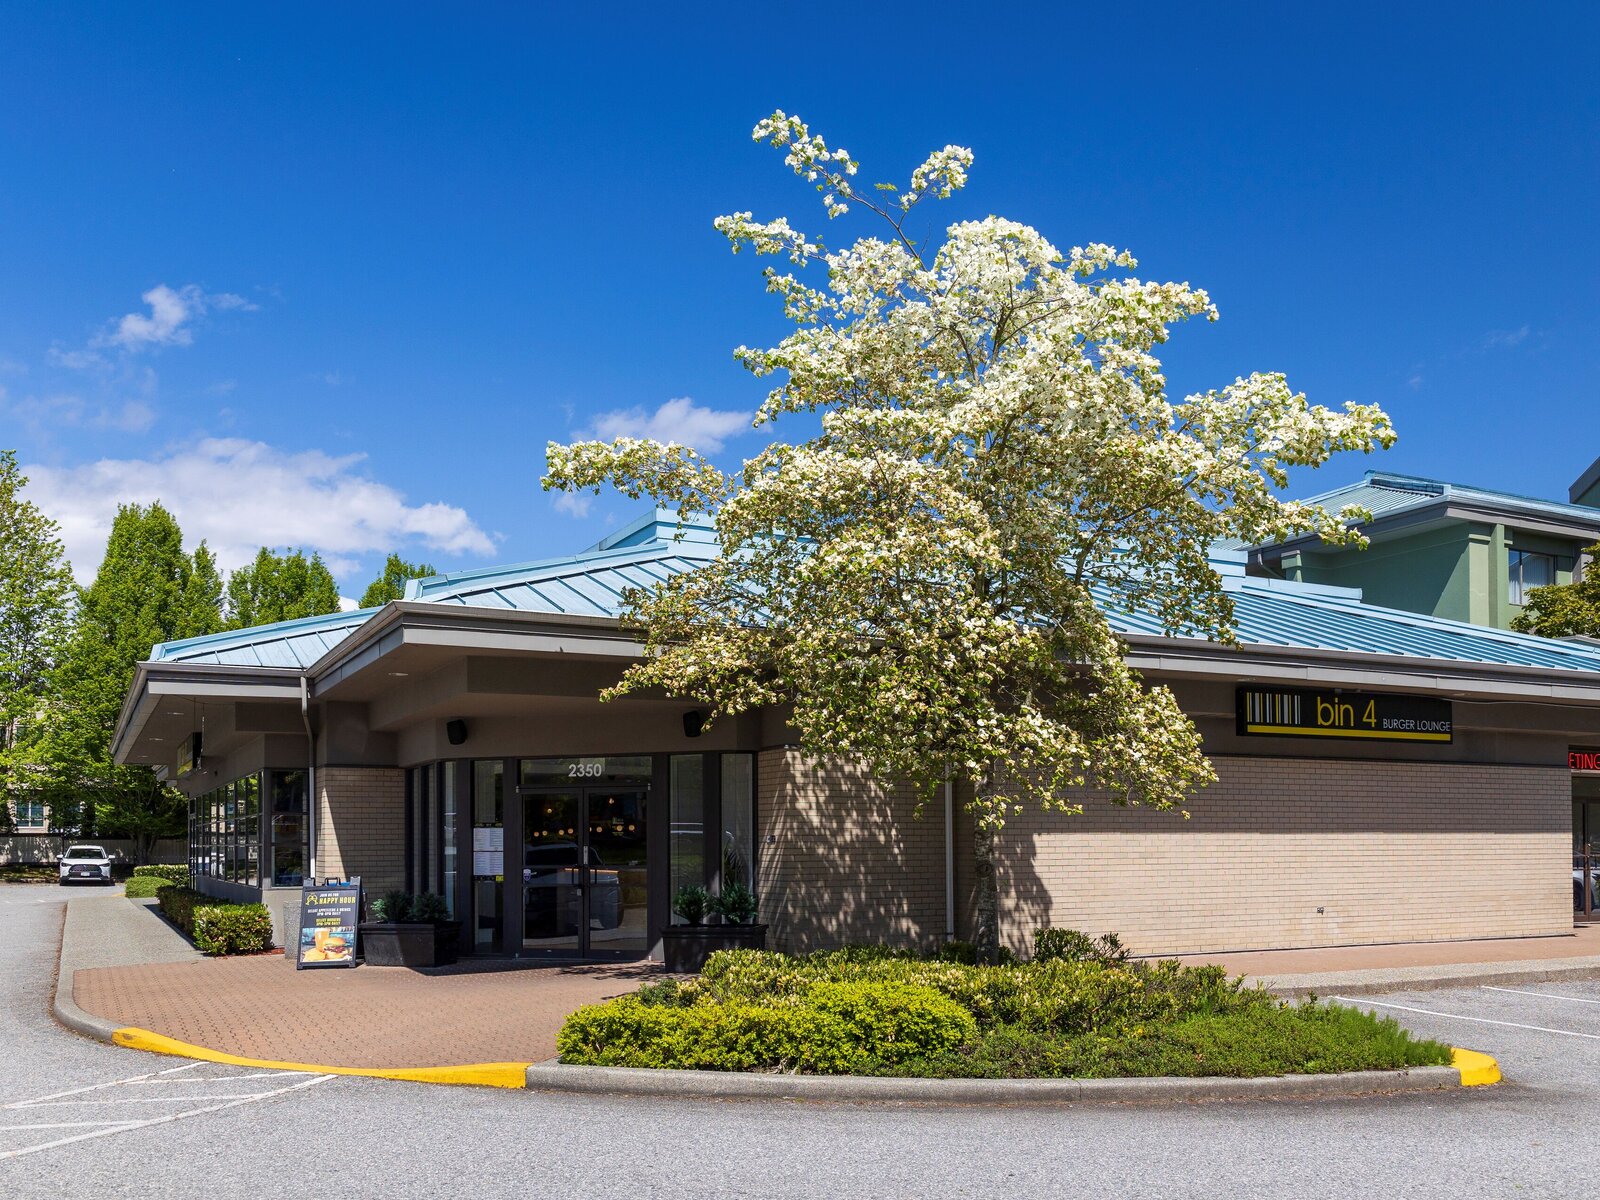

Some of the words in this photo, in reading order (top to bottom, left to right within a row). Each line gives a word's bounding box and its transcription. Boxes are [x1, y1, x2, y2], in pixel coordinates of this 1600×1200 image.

[1317, 696, 1354, 726] bin
[1362, 699, 1377, 727] 4
[1382, 718, 1415, 730] BURGER
[1416, 720, 1451, 732] LOUNGE
[568, 763, 602, 777] 2350
[339, 896, 356, 904] HOUR
